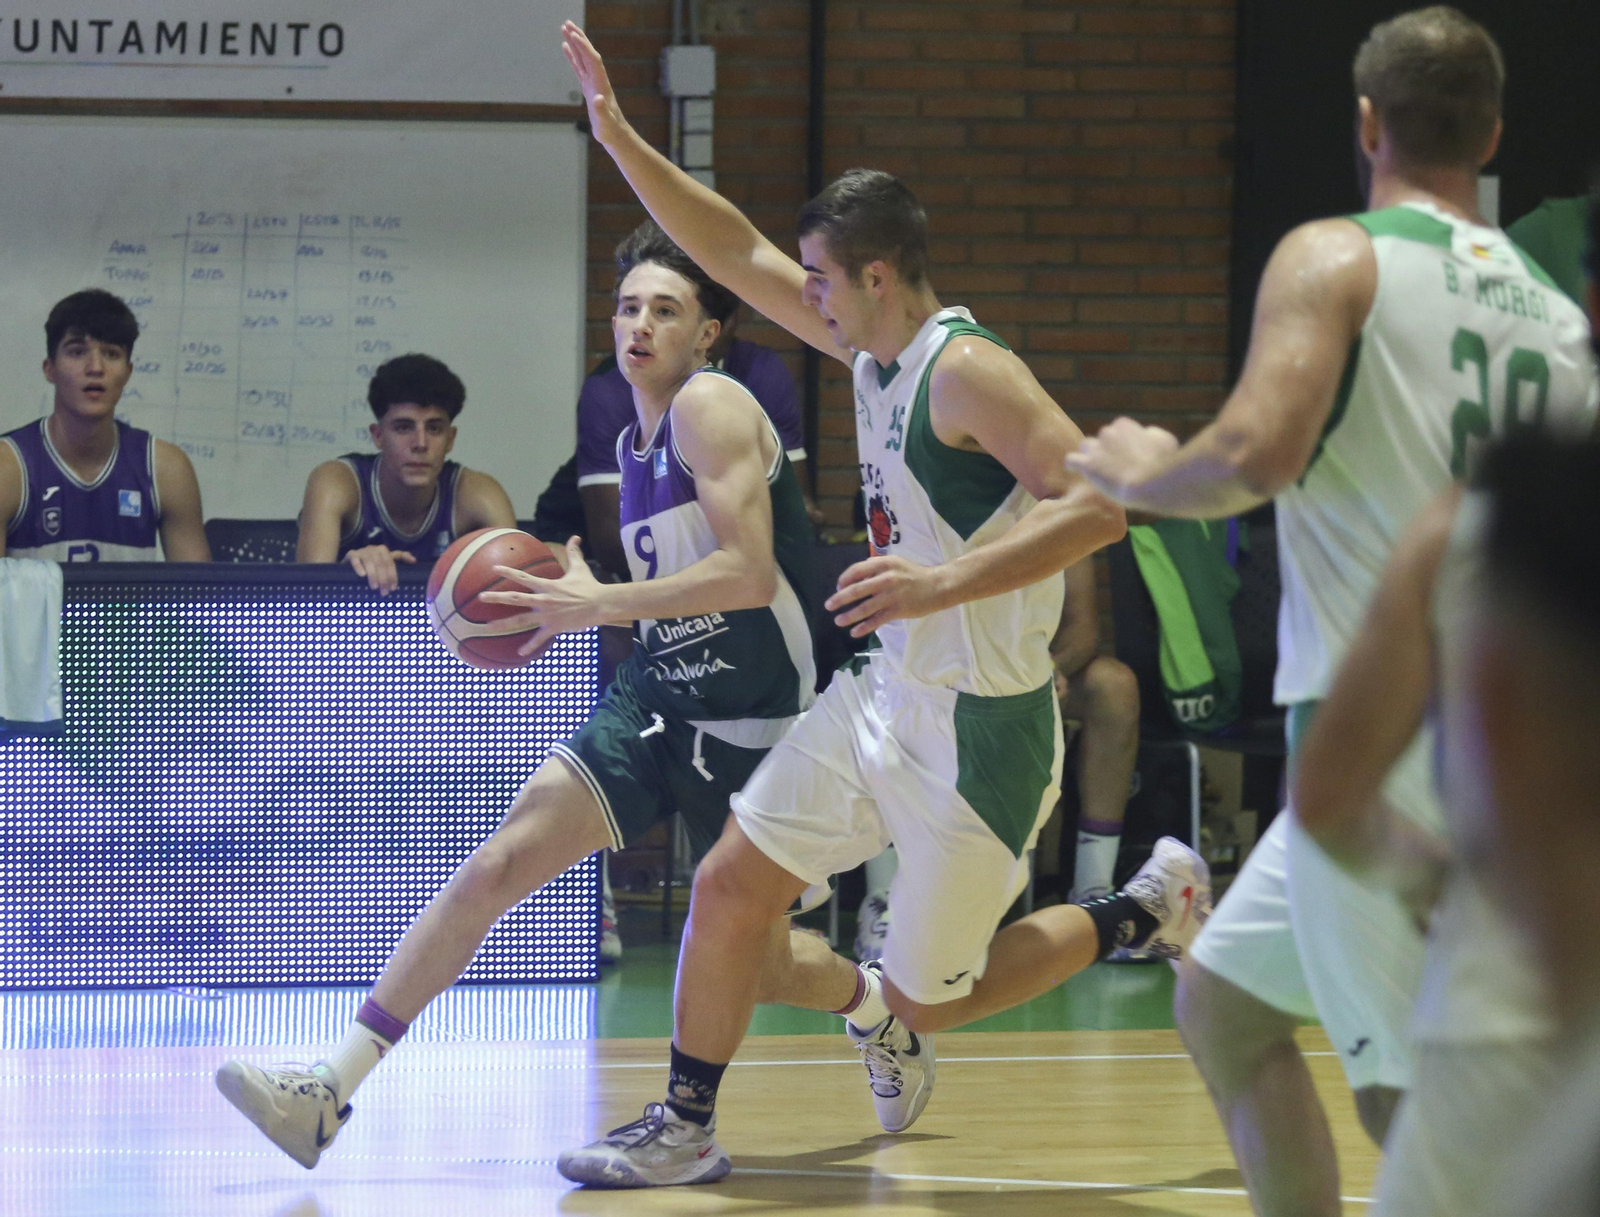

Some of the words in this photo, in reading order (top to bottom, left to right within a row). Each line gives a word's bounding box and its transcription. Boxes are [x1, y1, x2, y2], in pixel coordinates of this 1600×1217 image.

[0, 18, 346, 58] UNTAMIENTO
[634, 525, 658, 580] 9
[656, 612, 725, 644] Unicaja
